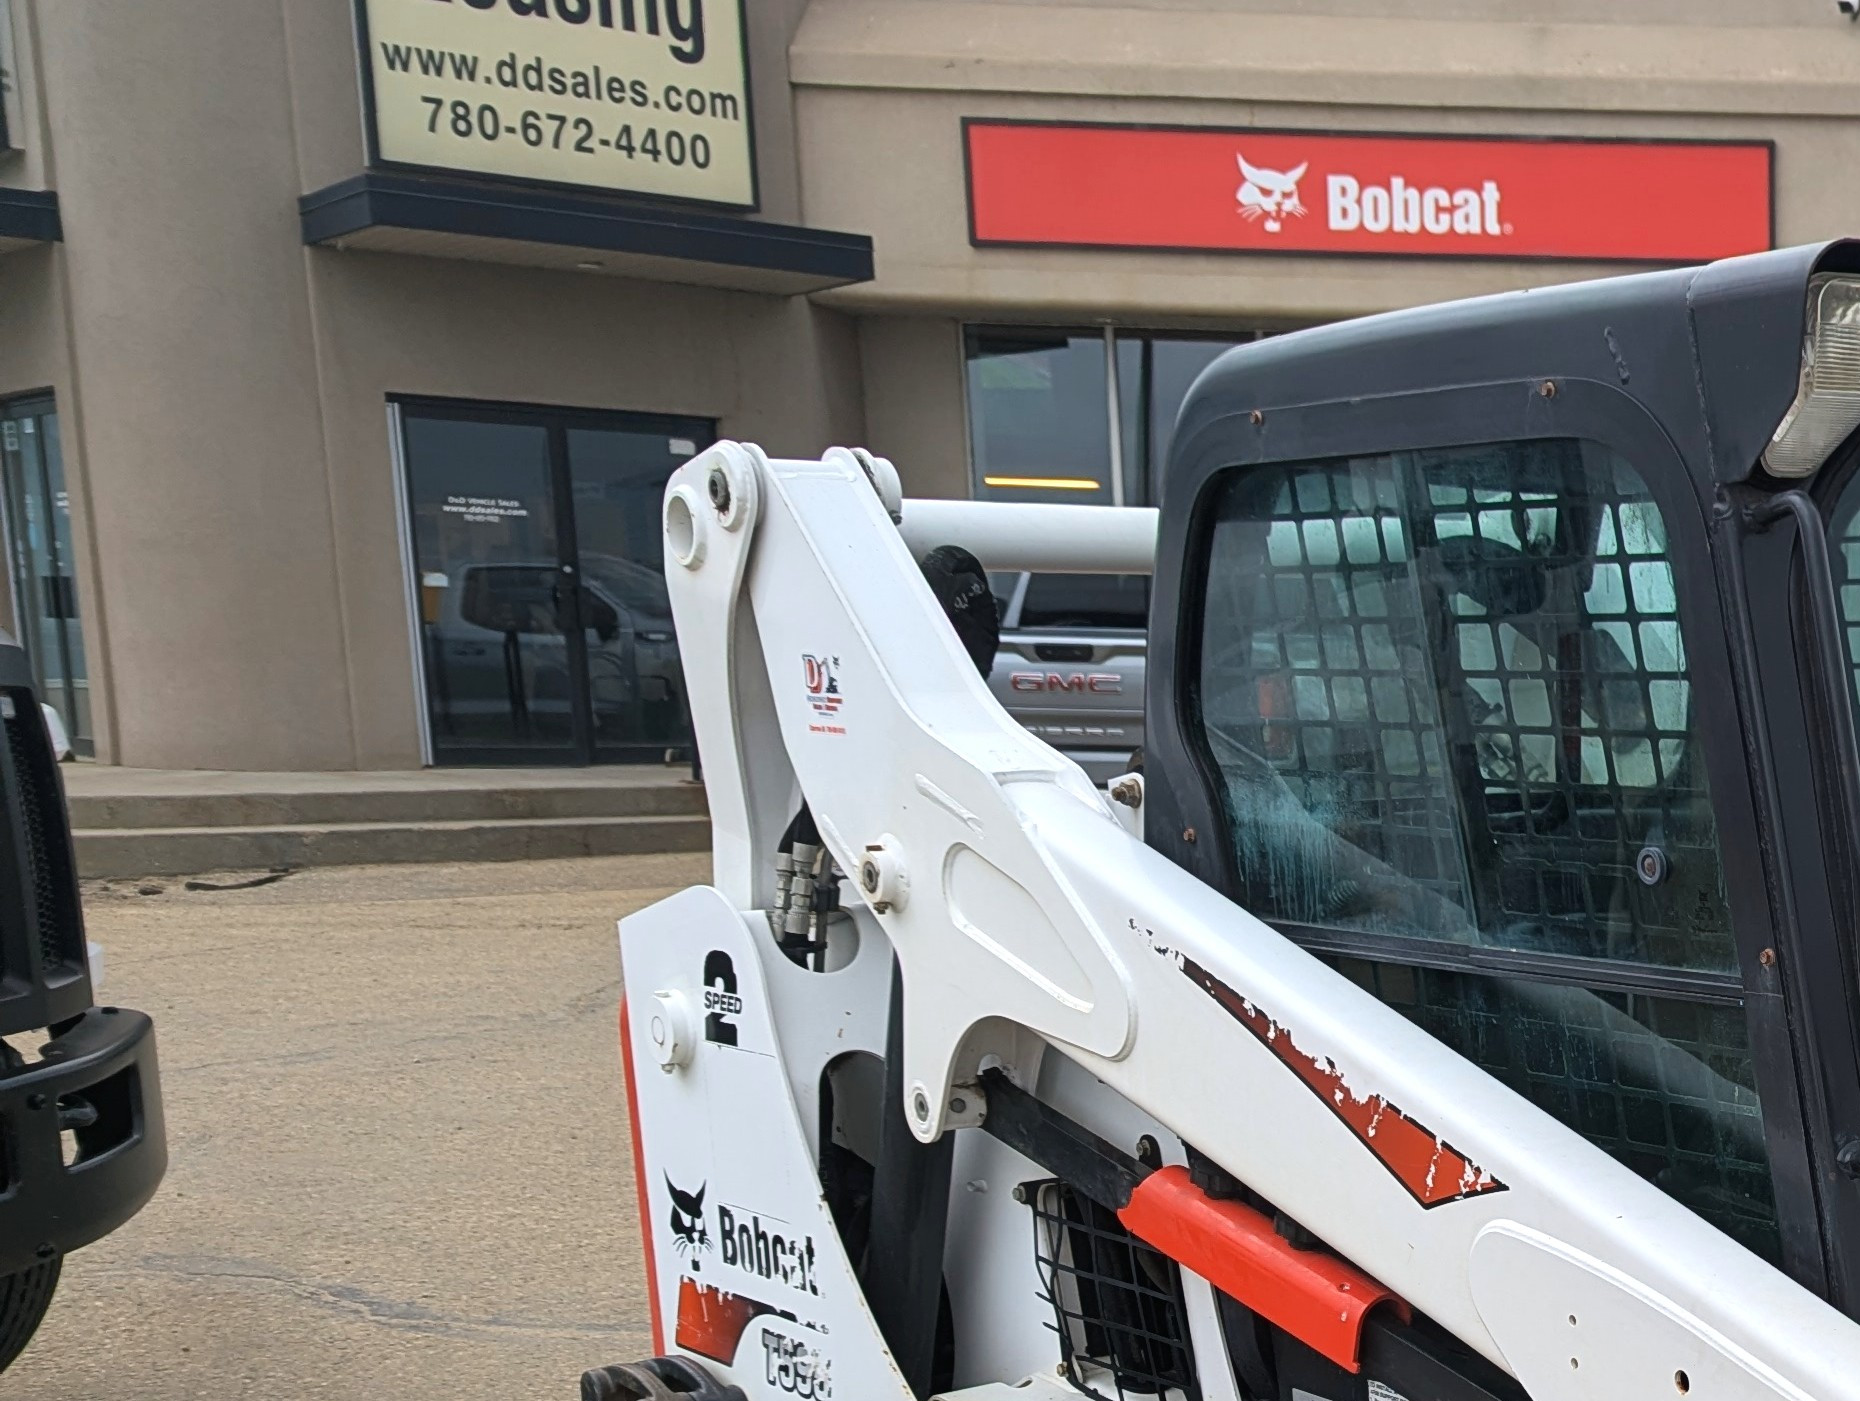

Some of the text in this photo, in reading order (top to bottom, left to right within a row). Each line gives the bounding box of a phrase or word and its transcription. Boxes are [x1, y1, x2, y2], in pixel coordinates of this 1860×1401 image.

[379, 41, 740, 121] www.ddsales.com
[420, 95, 711, 170] 780-672-4400
[1326, 174, 1501, 236] Bobcat
[1009, 672, 1122, 695] GMC
[704, 990, 742, 1015] SPEED
